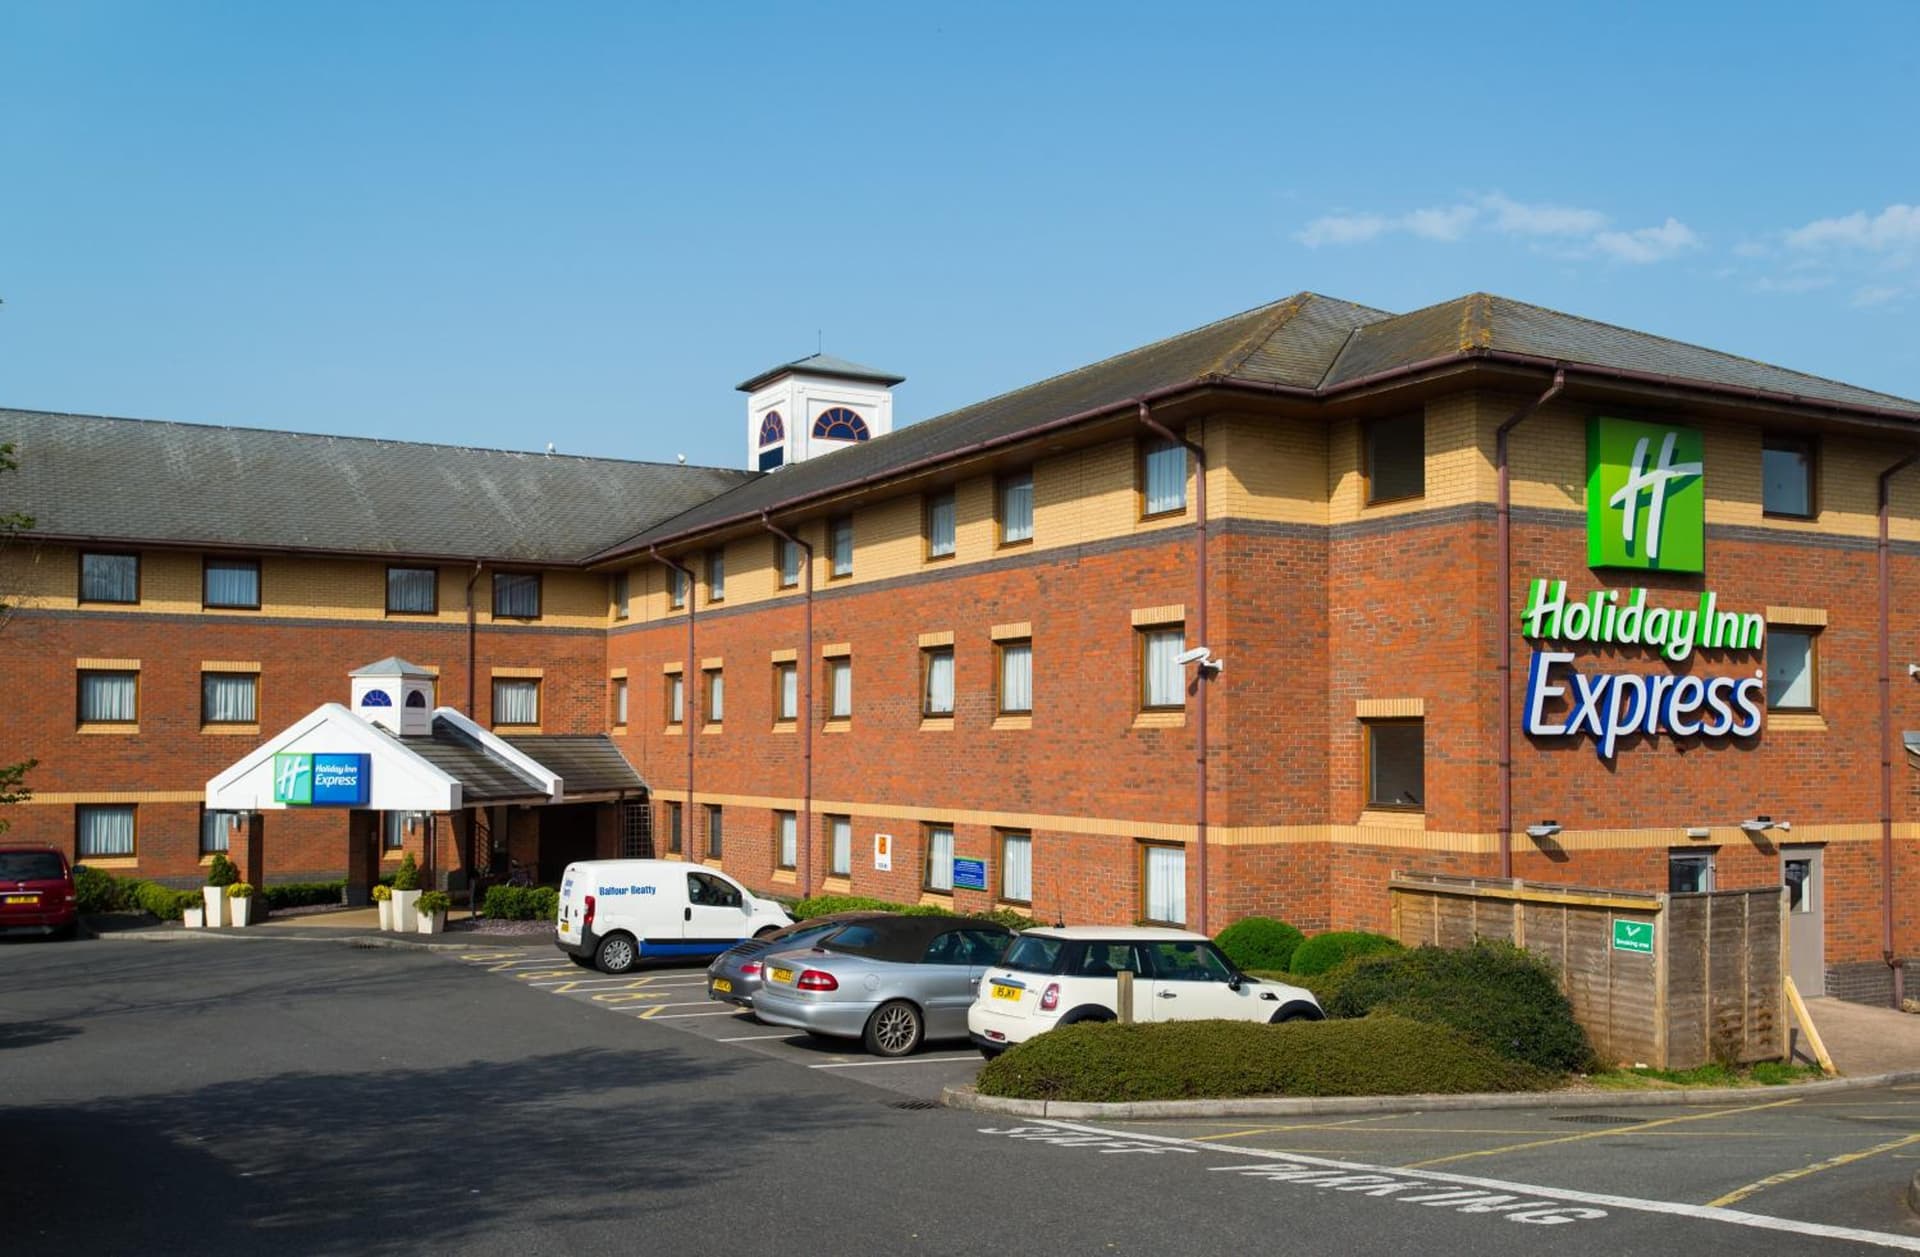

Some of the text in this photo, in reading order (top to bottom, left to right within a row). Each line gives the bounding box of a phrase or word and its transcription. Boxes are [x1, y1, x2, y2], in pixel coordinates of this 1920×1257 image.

[1522, 578, 1764, 661] Holiday Inn
[1523, 651, 1764, 759] Express
[315, 763, 358, 775] Holiday Inn
[315, 774, 358, 788] Express
[598, 885, 657, 896] Balfour Beatty
[977, 1126, 1200, 1155] STAFF
[1206, 1162, 1610, 1225] PARKING
